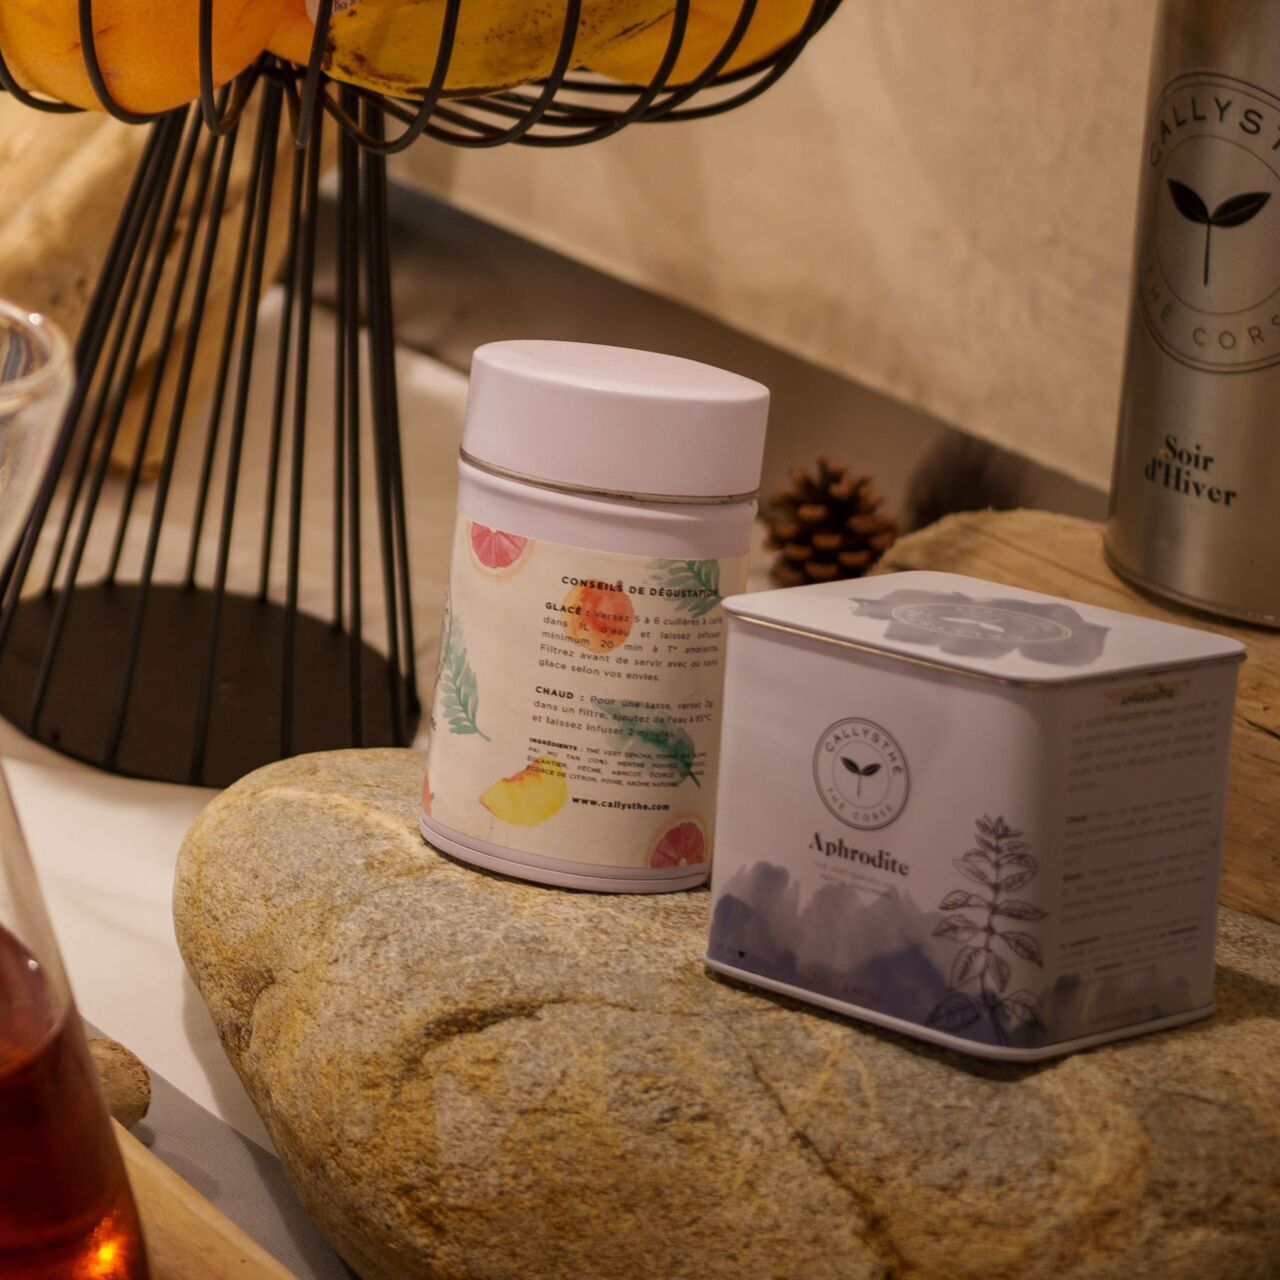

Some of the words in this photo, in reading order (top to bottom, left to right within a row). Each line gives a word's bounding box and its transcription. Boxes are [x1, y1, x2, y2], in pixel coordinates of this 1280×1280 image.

[1164, 433, 1215, 473] Soir
[561, 576, 624, 593] CONSEILS
[629, 586, 645, 596] DE
[543, 616, 568, 628] dans
[640, 631, 651, 639] et
[660, 631, 690, 640] laissez
[594, 610, 630, 623] Versez
[653, 616, 660, 625] 6
[541, 631, 590, 647] minimum
[600, 640, 614, 650] 20
[624, 642, 643, 652] min
[540, 644, 575, 658] Filtrez
[580, 652, 611, 664] avant
[615, 655, 629, 665] de
[634, 659, 662, 668] servir
[538, 657, 567, 673] glace
[571, 664, 600, 677] selon
[603, 669, 622, 679] vos
[535, 685, 575, 700] CHAUD
[590, 695, 616, 706] Pour
[621, 700, 640, 709] une
[532, 699, 559, 713] dans
[562, 705, 575, 714] un
[578, 707, 608, 720] filtre,
[652, 715, 665, 724] de
[531, 714, 544, 724] et
[545, 715, 582, 731] laissez
[586, 723, 624, 737] infuser
[627, 727, 635, 737] 2
[566, 753, 581, 761] TAN
[603, 750, 621, 758] VERT
[571, 796, 671, 812] www.callysthe.com
[808, 831, 910, 877] Aphrodite
